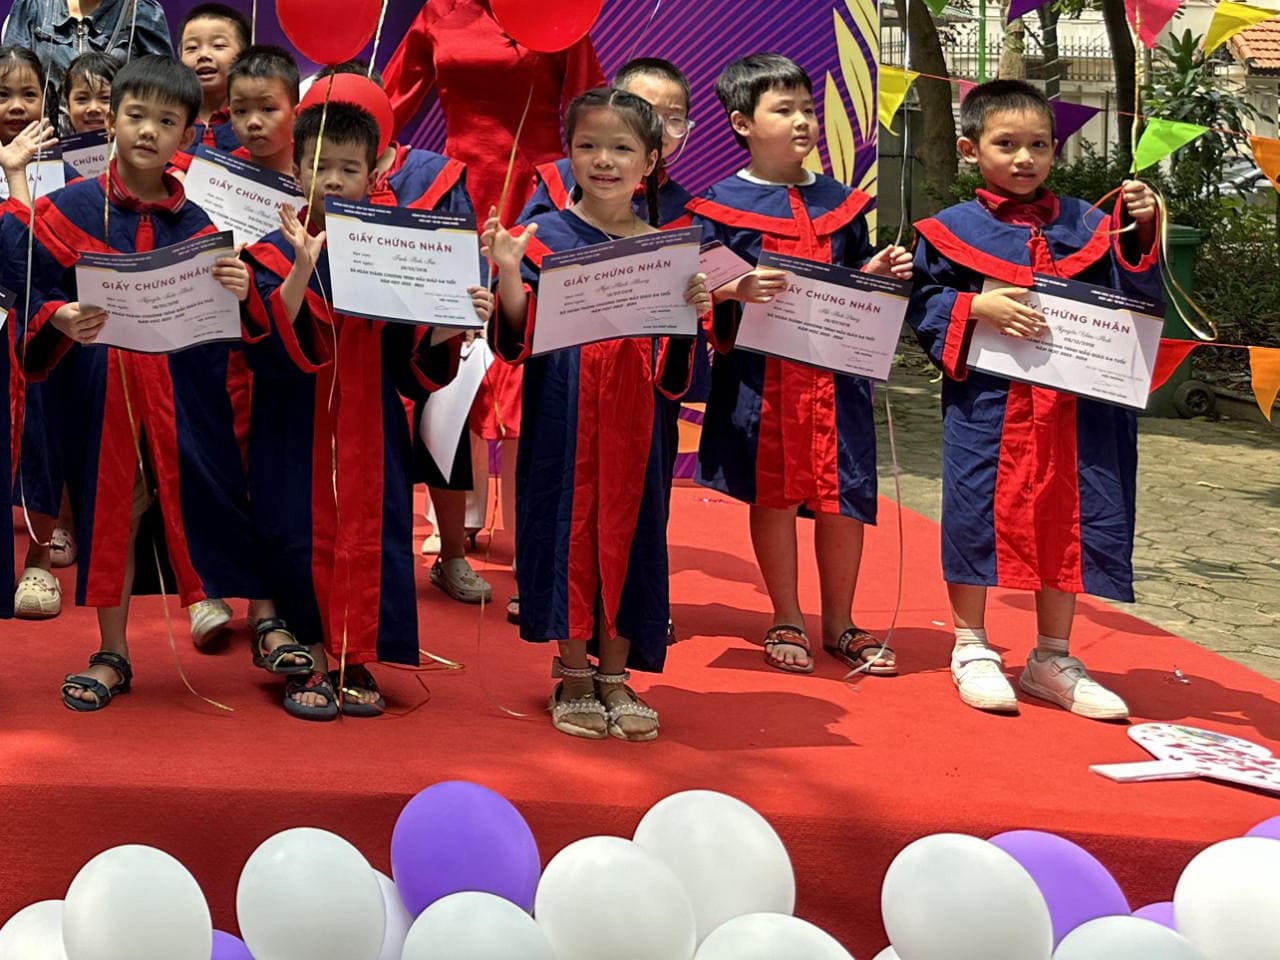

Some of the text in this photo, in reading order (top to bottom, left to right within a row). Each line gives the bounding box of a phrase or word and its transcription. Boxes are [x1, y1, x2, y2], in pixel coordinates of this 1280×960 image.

[72, 154, 105, 167] CHỨNG
[209, 177, 272, 206] GIẤY CHỨNG
[349, 232, 373, 243] GIẤY
[377, 236, 416, 249] CHỨNG
[102, 280, 129, 291] GIẤY
[135, 276, 176, 291] CHỨNG
[563, 274, 590, 288] GIẤY
[594, 264, 634, 281] CHỨNG
[805, 288, 846, 306] CHỨNG
[1042, 305, 1088, 324] CHỨNG
[1092, 318, 1131, 334] NHẬN
